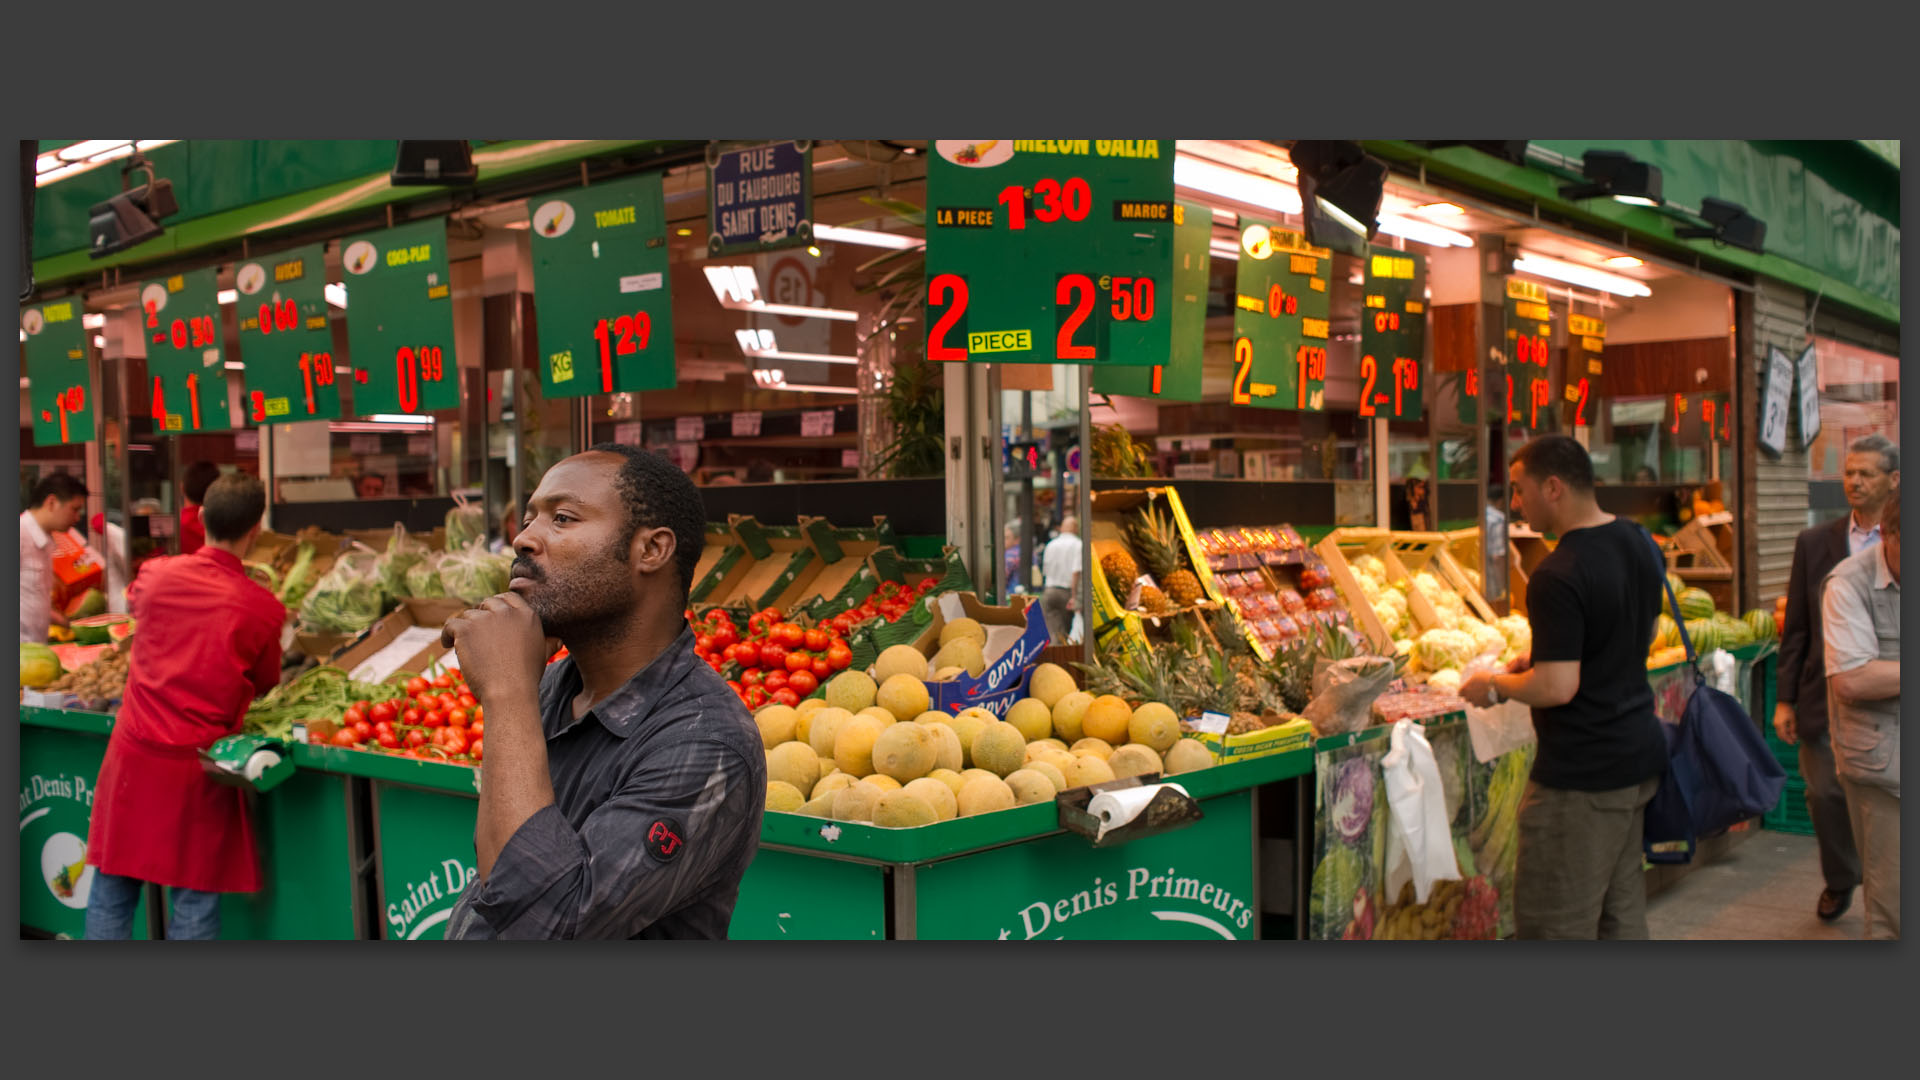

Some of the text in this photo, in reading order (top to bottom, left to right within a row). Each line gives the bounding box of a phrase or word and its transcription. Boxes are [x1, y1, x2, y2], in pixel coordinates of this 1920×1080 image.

[739, 147, 777, 174] RUE
[1095, 140, 1160, 160] GALIA
[717, 171, 800, 207] DU FAUBOURG
[594, 205, 637, 229] TOMATE
[721, 202, 797, 238] SAINT DENIS
[936, 209, 953, 225] LA
[957, 209, 993, 226] PIECE
[1121, 202, 1168, 220] MAROC
[927, 272, 1029, 362] 2 PIECE
[552, 353, 573, 375] KG
[1233, 336, 1253, 405] 2
[1359, 354, 1377, 417] 2
[250, 390, 267, 423] 3
[988, 639, 1025, 689] envy
[31, 774, 72, 801] Denis
[387, 870, 443, 938] Saint
[1018, 867, 1254, 940] Denis Primeurs
